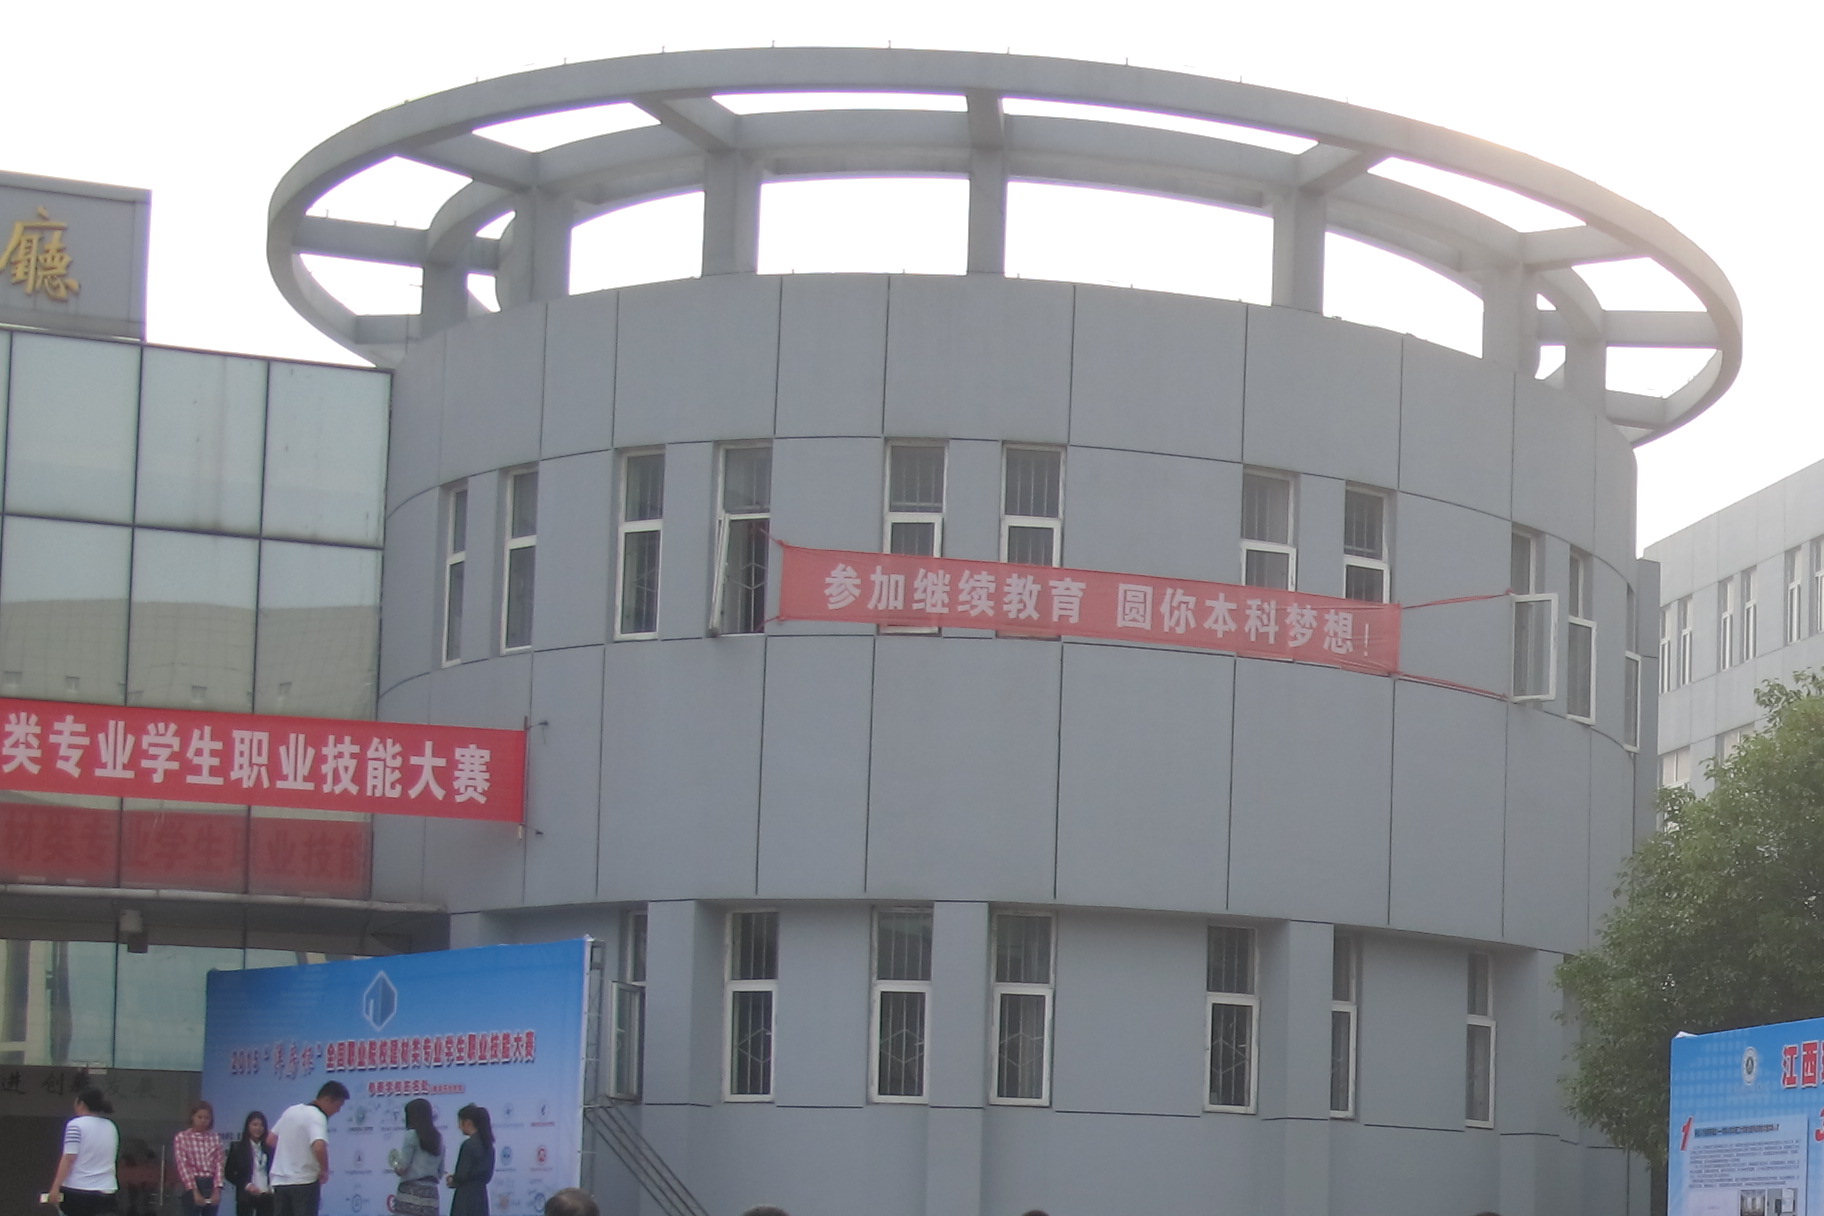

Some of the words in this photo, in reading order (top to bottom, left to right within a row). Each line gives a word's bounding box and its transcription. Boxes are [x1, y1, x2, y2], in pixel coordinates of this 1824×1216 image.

[825, 562, 1087, 625] 参加继续教育
[2, 711, 492, 805] 类专业学生职业技能大赛
[1679, 1116, 1695, 1152] 1
